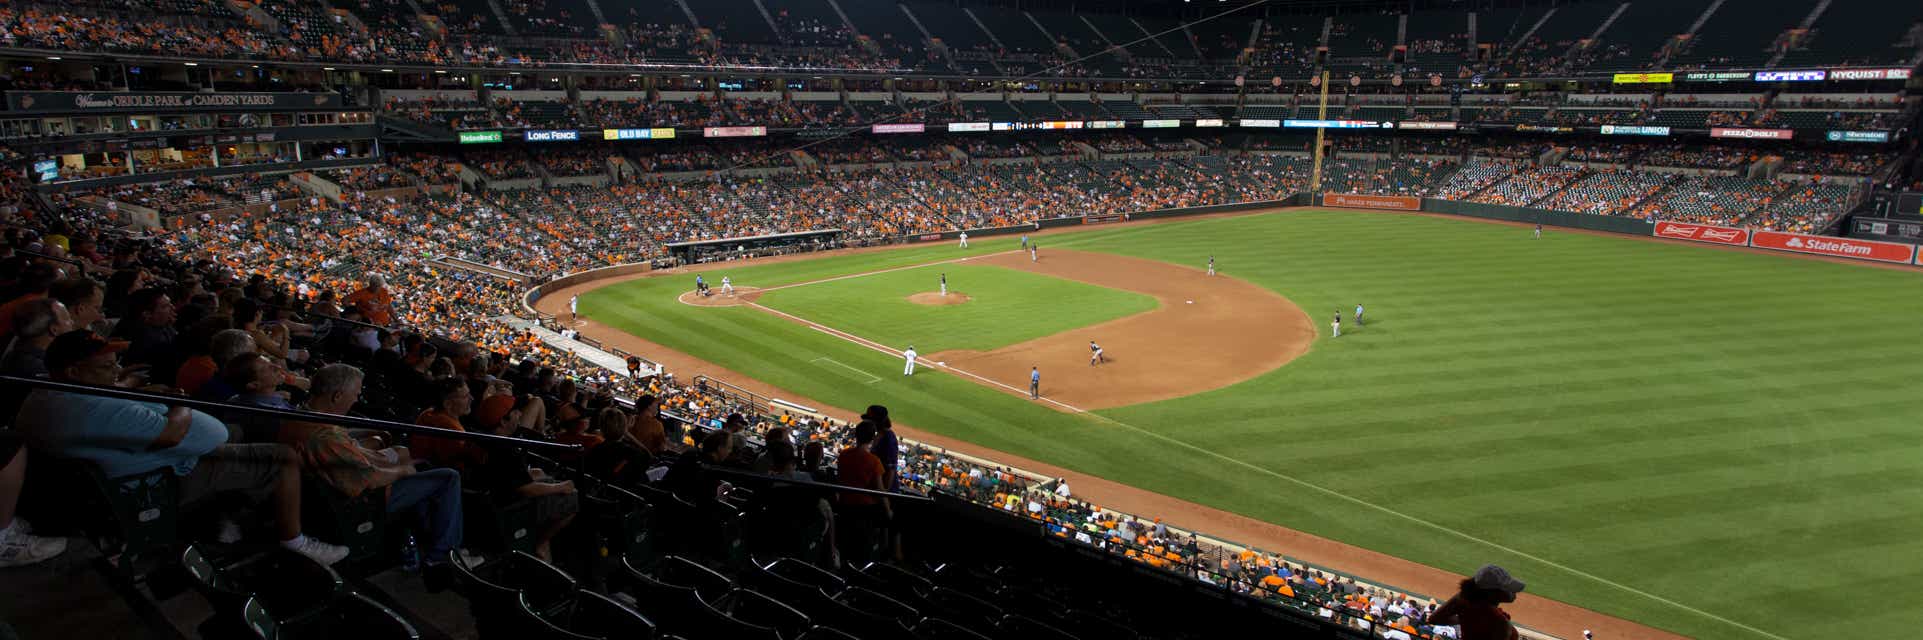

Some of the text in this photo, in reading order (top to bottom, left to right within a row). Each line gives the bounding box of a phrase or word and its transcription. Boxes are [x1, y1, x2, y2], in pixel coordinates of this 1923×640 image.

[1830, 70, 1882, 79] NYQUIST
[112, 96, 154, 107] ORIOLE
[154, 95, 184, 106] PARK
[193, 95, 239, 106] CAMDEN
[239, 95, 275, 105] YARDS
[527, 131, 577, 141] LONG FENCE
[635, 129, 650, 139] BAY
[1641, 126, 1670, 136] UNION
